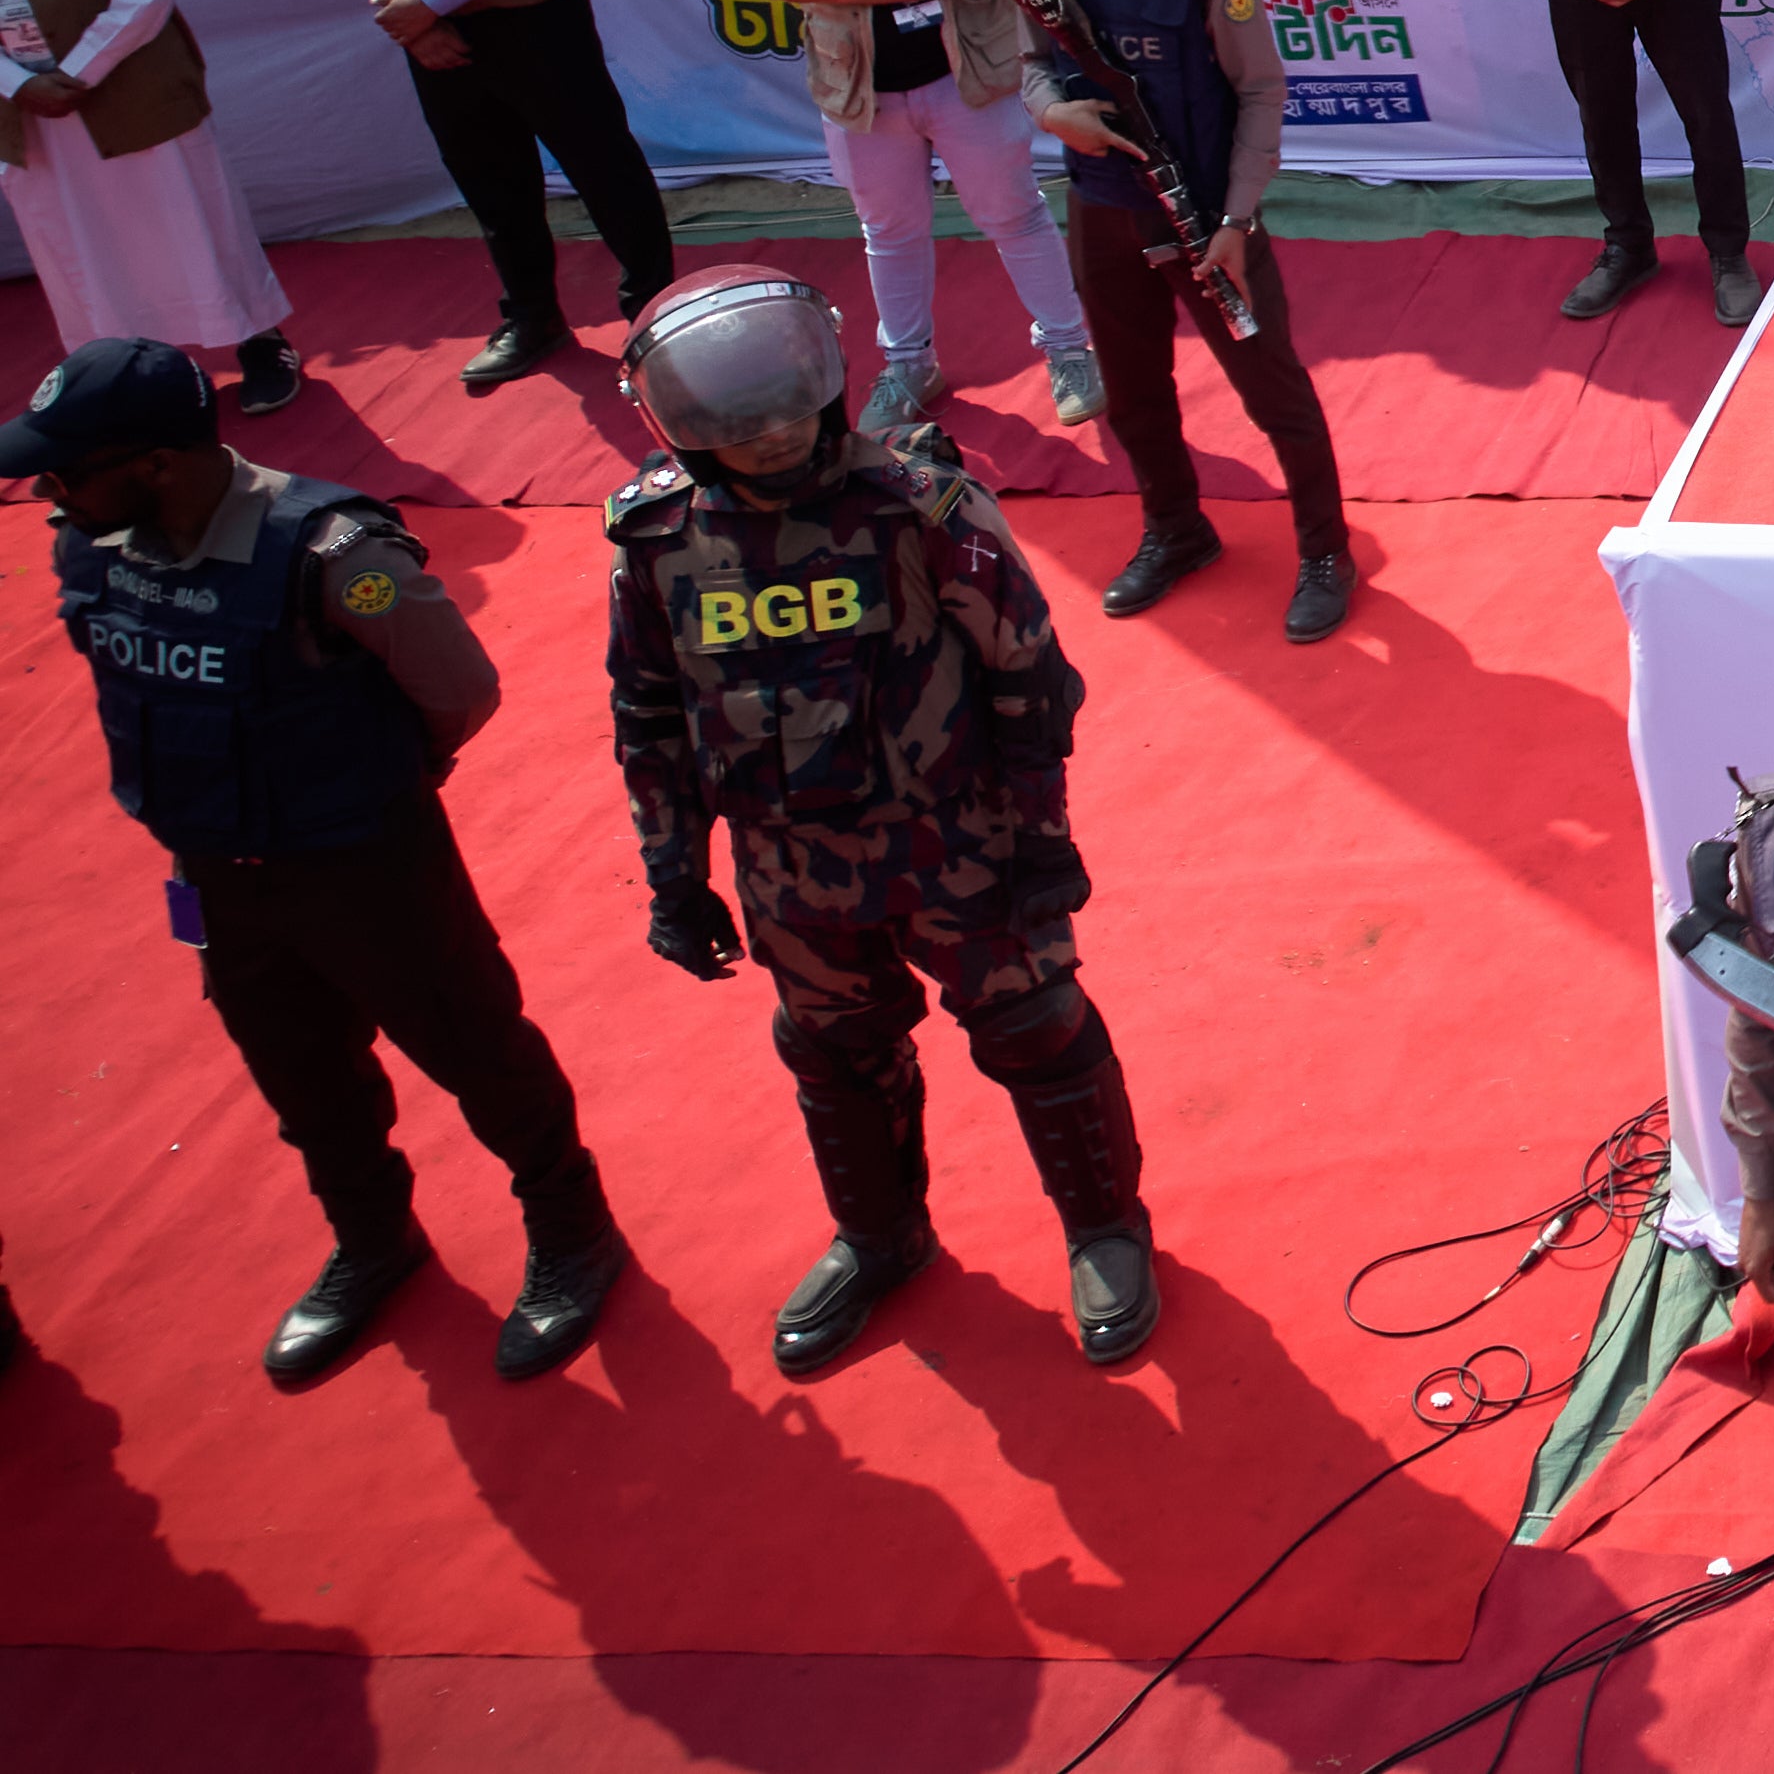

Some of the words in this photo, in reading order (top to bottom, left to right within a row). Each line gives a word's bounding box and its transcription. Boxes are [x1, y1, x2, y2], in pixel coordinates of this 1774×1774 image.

[1373, 82, 1407, 94] নগর
[698, 576, 863, 646] BGB
[89, 623, 226, 684] POLICE
